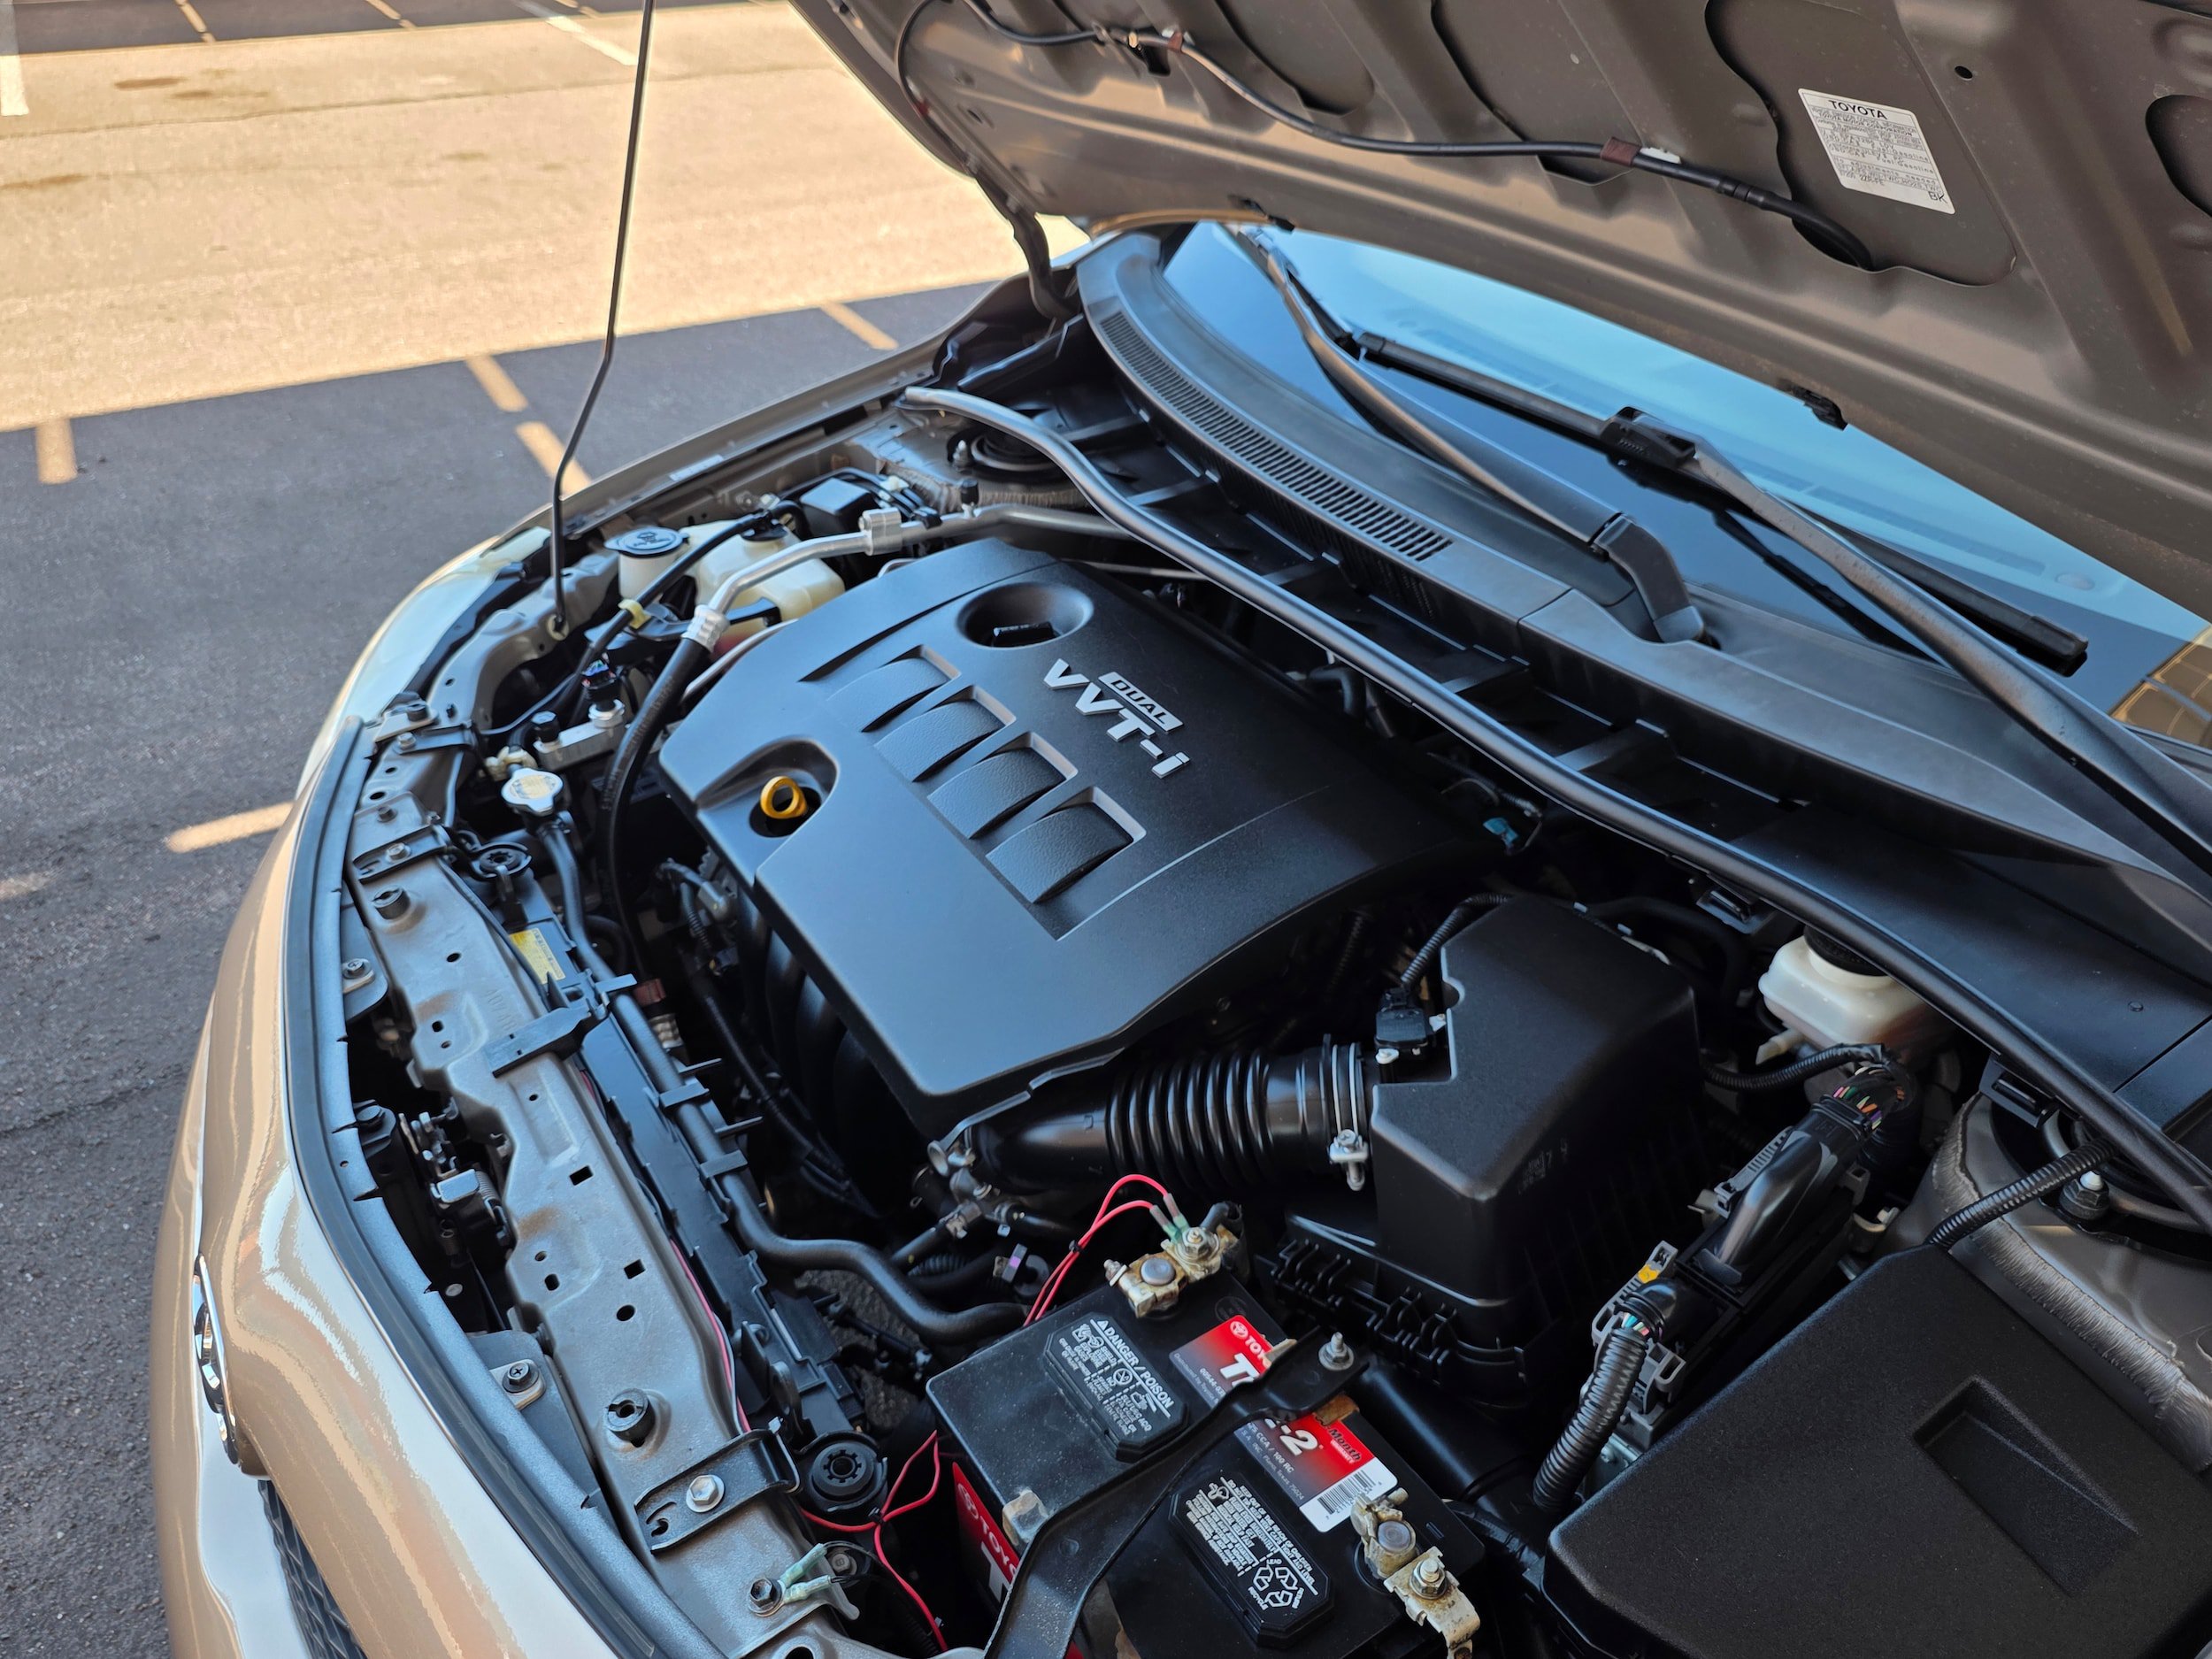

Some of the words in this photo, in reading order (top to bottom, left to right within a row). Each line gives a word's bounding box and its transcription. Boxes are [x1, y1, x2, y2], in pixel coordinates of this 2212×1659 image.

[1828, 99, 1888, 120] TOYOTA
[1928, 191, 1948, 204] BK
[1110, 679, 1167, 725] DUAL
[1103, 1326, 1140, 1366] DANGER
[1140, 1371, 1174, 1408] POISON
[1255, 1432, 1270, 1448] CCA
[1272, 1451, 1286, 1463] 100
[1282, 1462, 1294, 1473] RC
